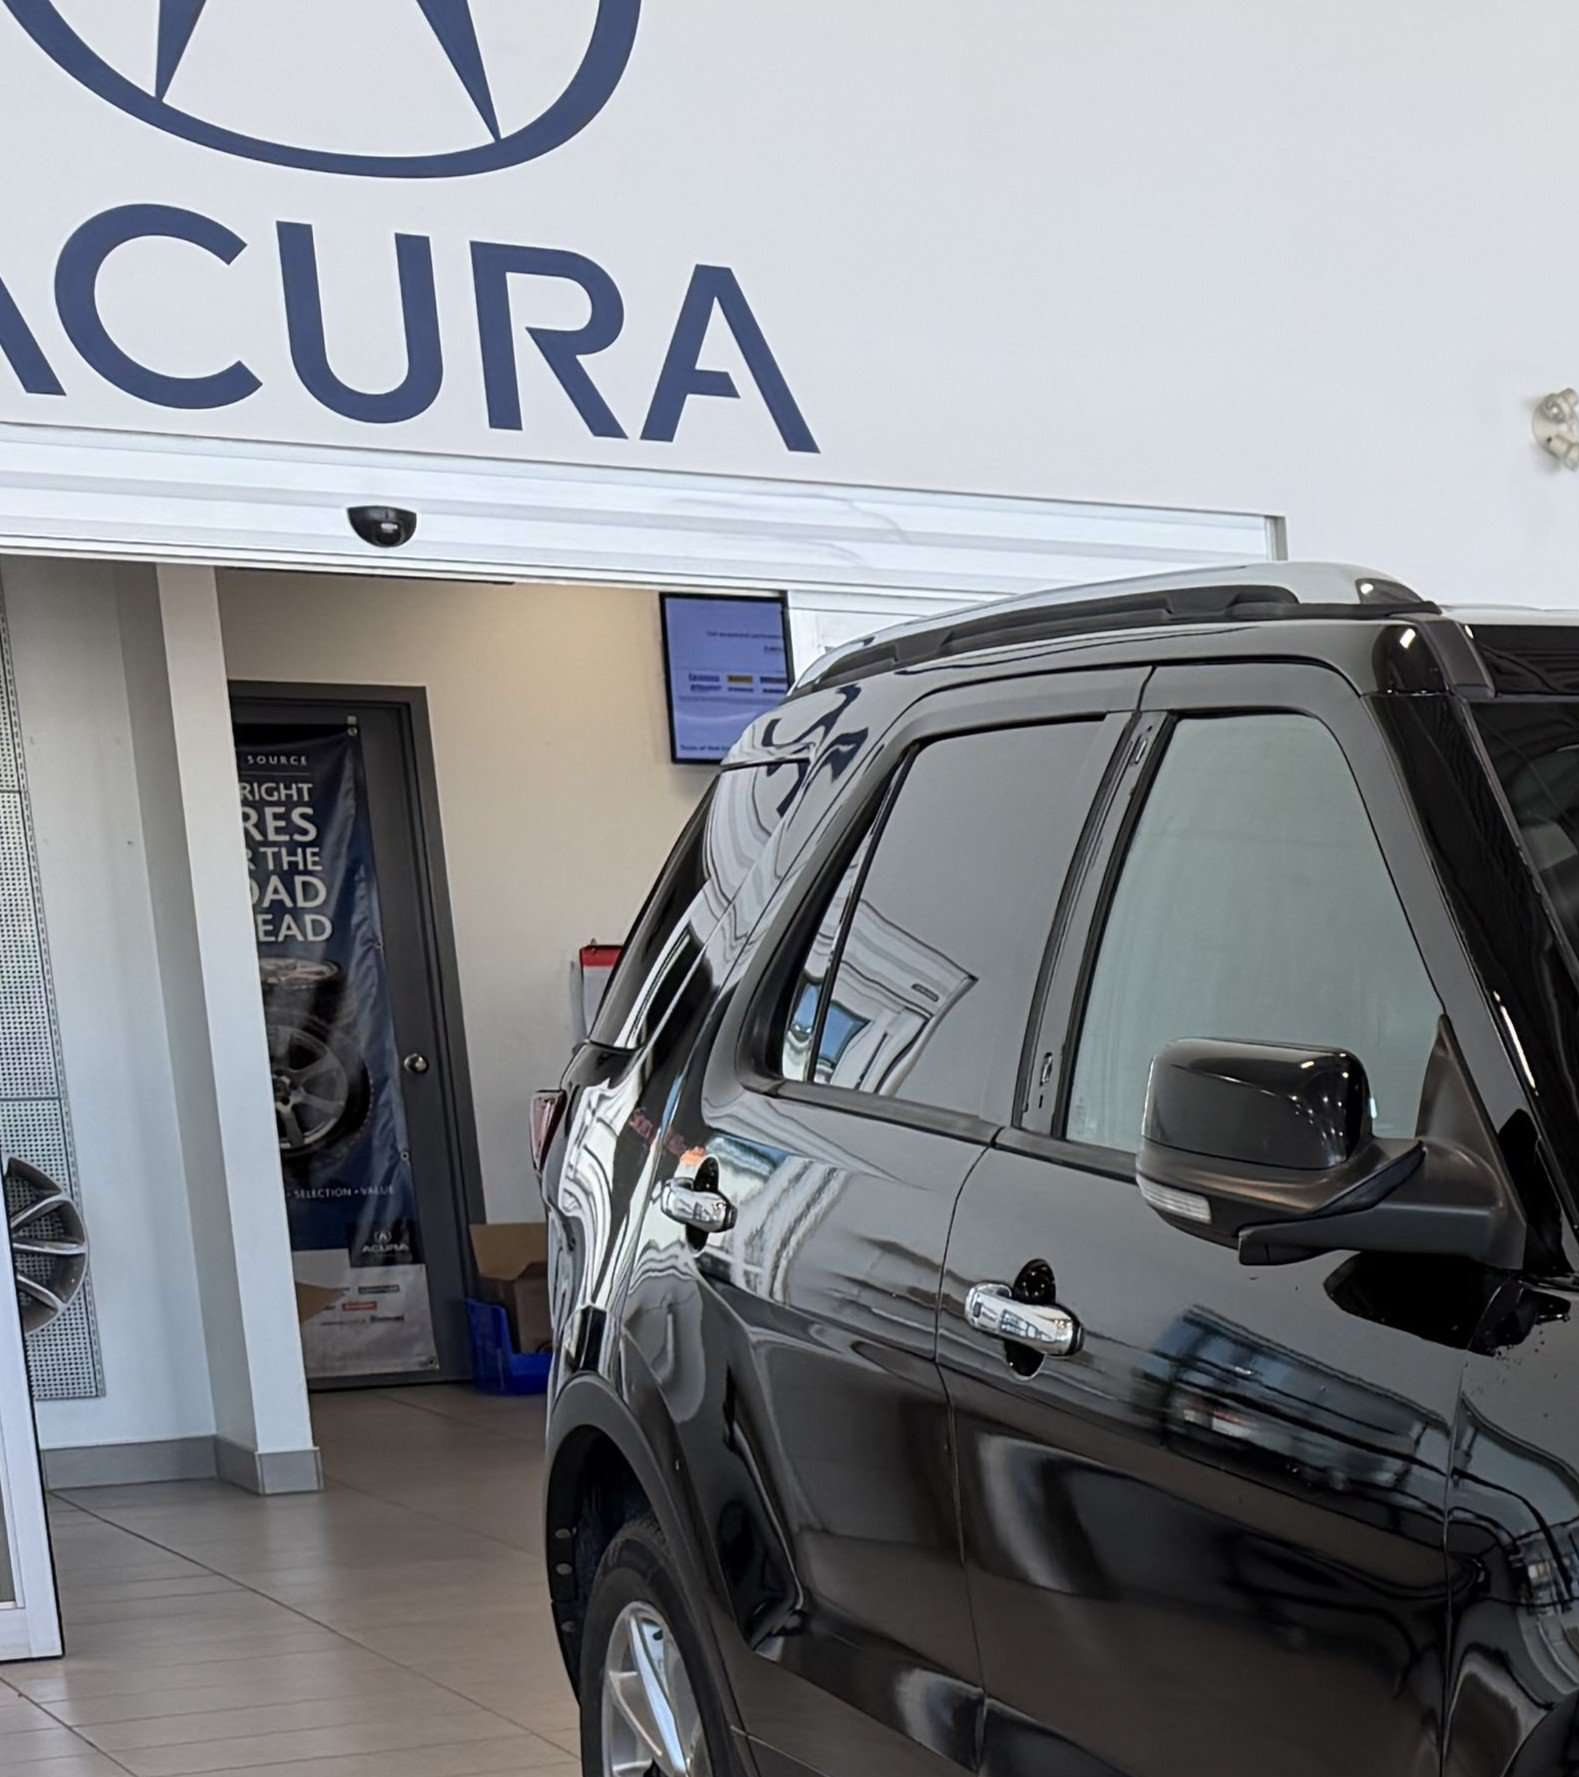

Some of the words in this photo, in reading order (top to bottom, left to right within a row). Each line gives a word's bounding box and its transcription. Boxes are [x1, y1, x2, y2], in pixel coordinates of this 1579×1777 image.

[247, 755, 308, 766] SOURCE
[239, 782, 313, 801] RIGHT
[259, 847, 323, 871] THE
[293, 1186, 352, 1199] SELECTION
[360, 1185, 395, 1196] VALUE
